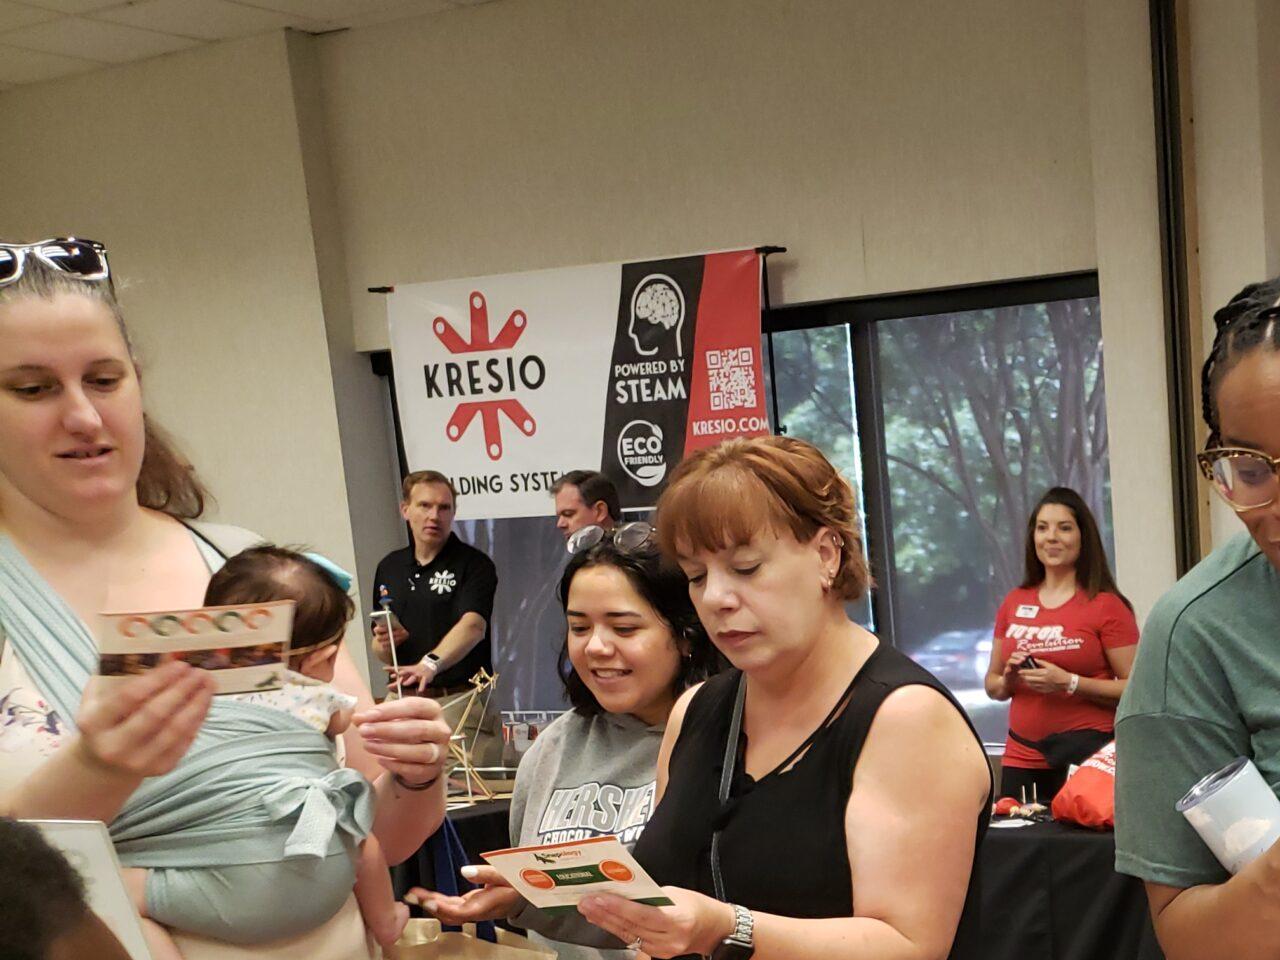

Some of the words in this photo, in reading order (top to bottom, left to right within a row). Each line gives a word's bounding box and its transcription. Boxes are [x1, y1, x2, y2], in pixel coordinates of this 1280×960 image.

[424, 355, 546, 398] KRESIO
[615, 360, 667, 378] POWERED
[670, 359, 685, 373] BY
[615, 378, 687, 404] STEAM
[692, 416, 769, 437] KRESIO.COM
[621, 435, 662, 455] ECO
[624, 454, 664, 466] FRIENDLY
[450, 475, 503, 496] LDING
[510, 471, 563, 493] SYSTE
[1005, 624, 1064, 640] TUTOR
[538, 780, 657, 834] HERSHE
